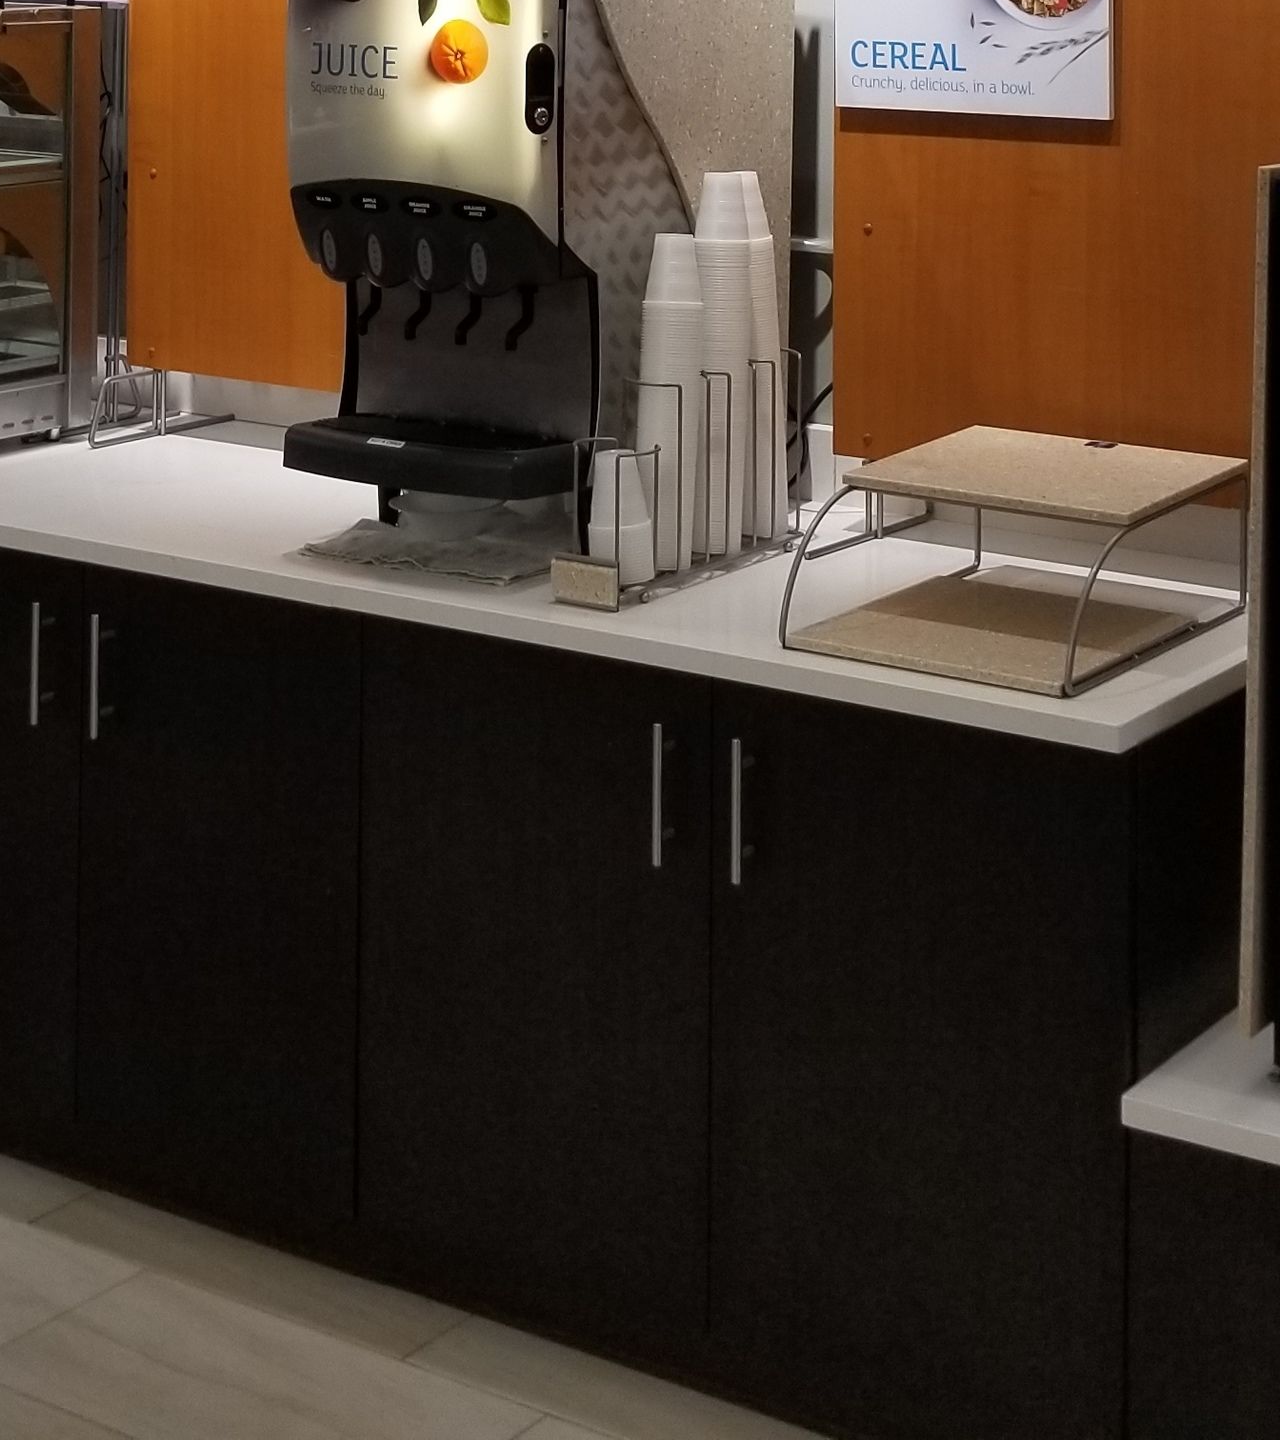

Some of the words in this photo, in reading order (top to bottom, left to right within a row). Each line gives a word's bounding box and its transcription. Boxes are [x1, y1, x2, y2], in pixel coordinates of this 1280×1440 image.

[311, 42, 399, 79] JUICE
[850, 40, 967, 72] CEREAL
[310, 81, 348, 96] Squeeze
[350, 84, 365, 96] the
[973, 79, 985, 93] in
[989, 83, 997, 94] a
[1001, 80, 1035, 96] bowl.
